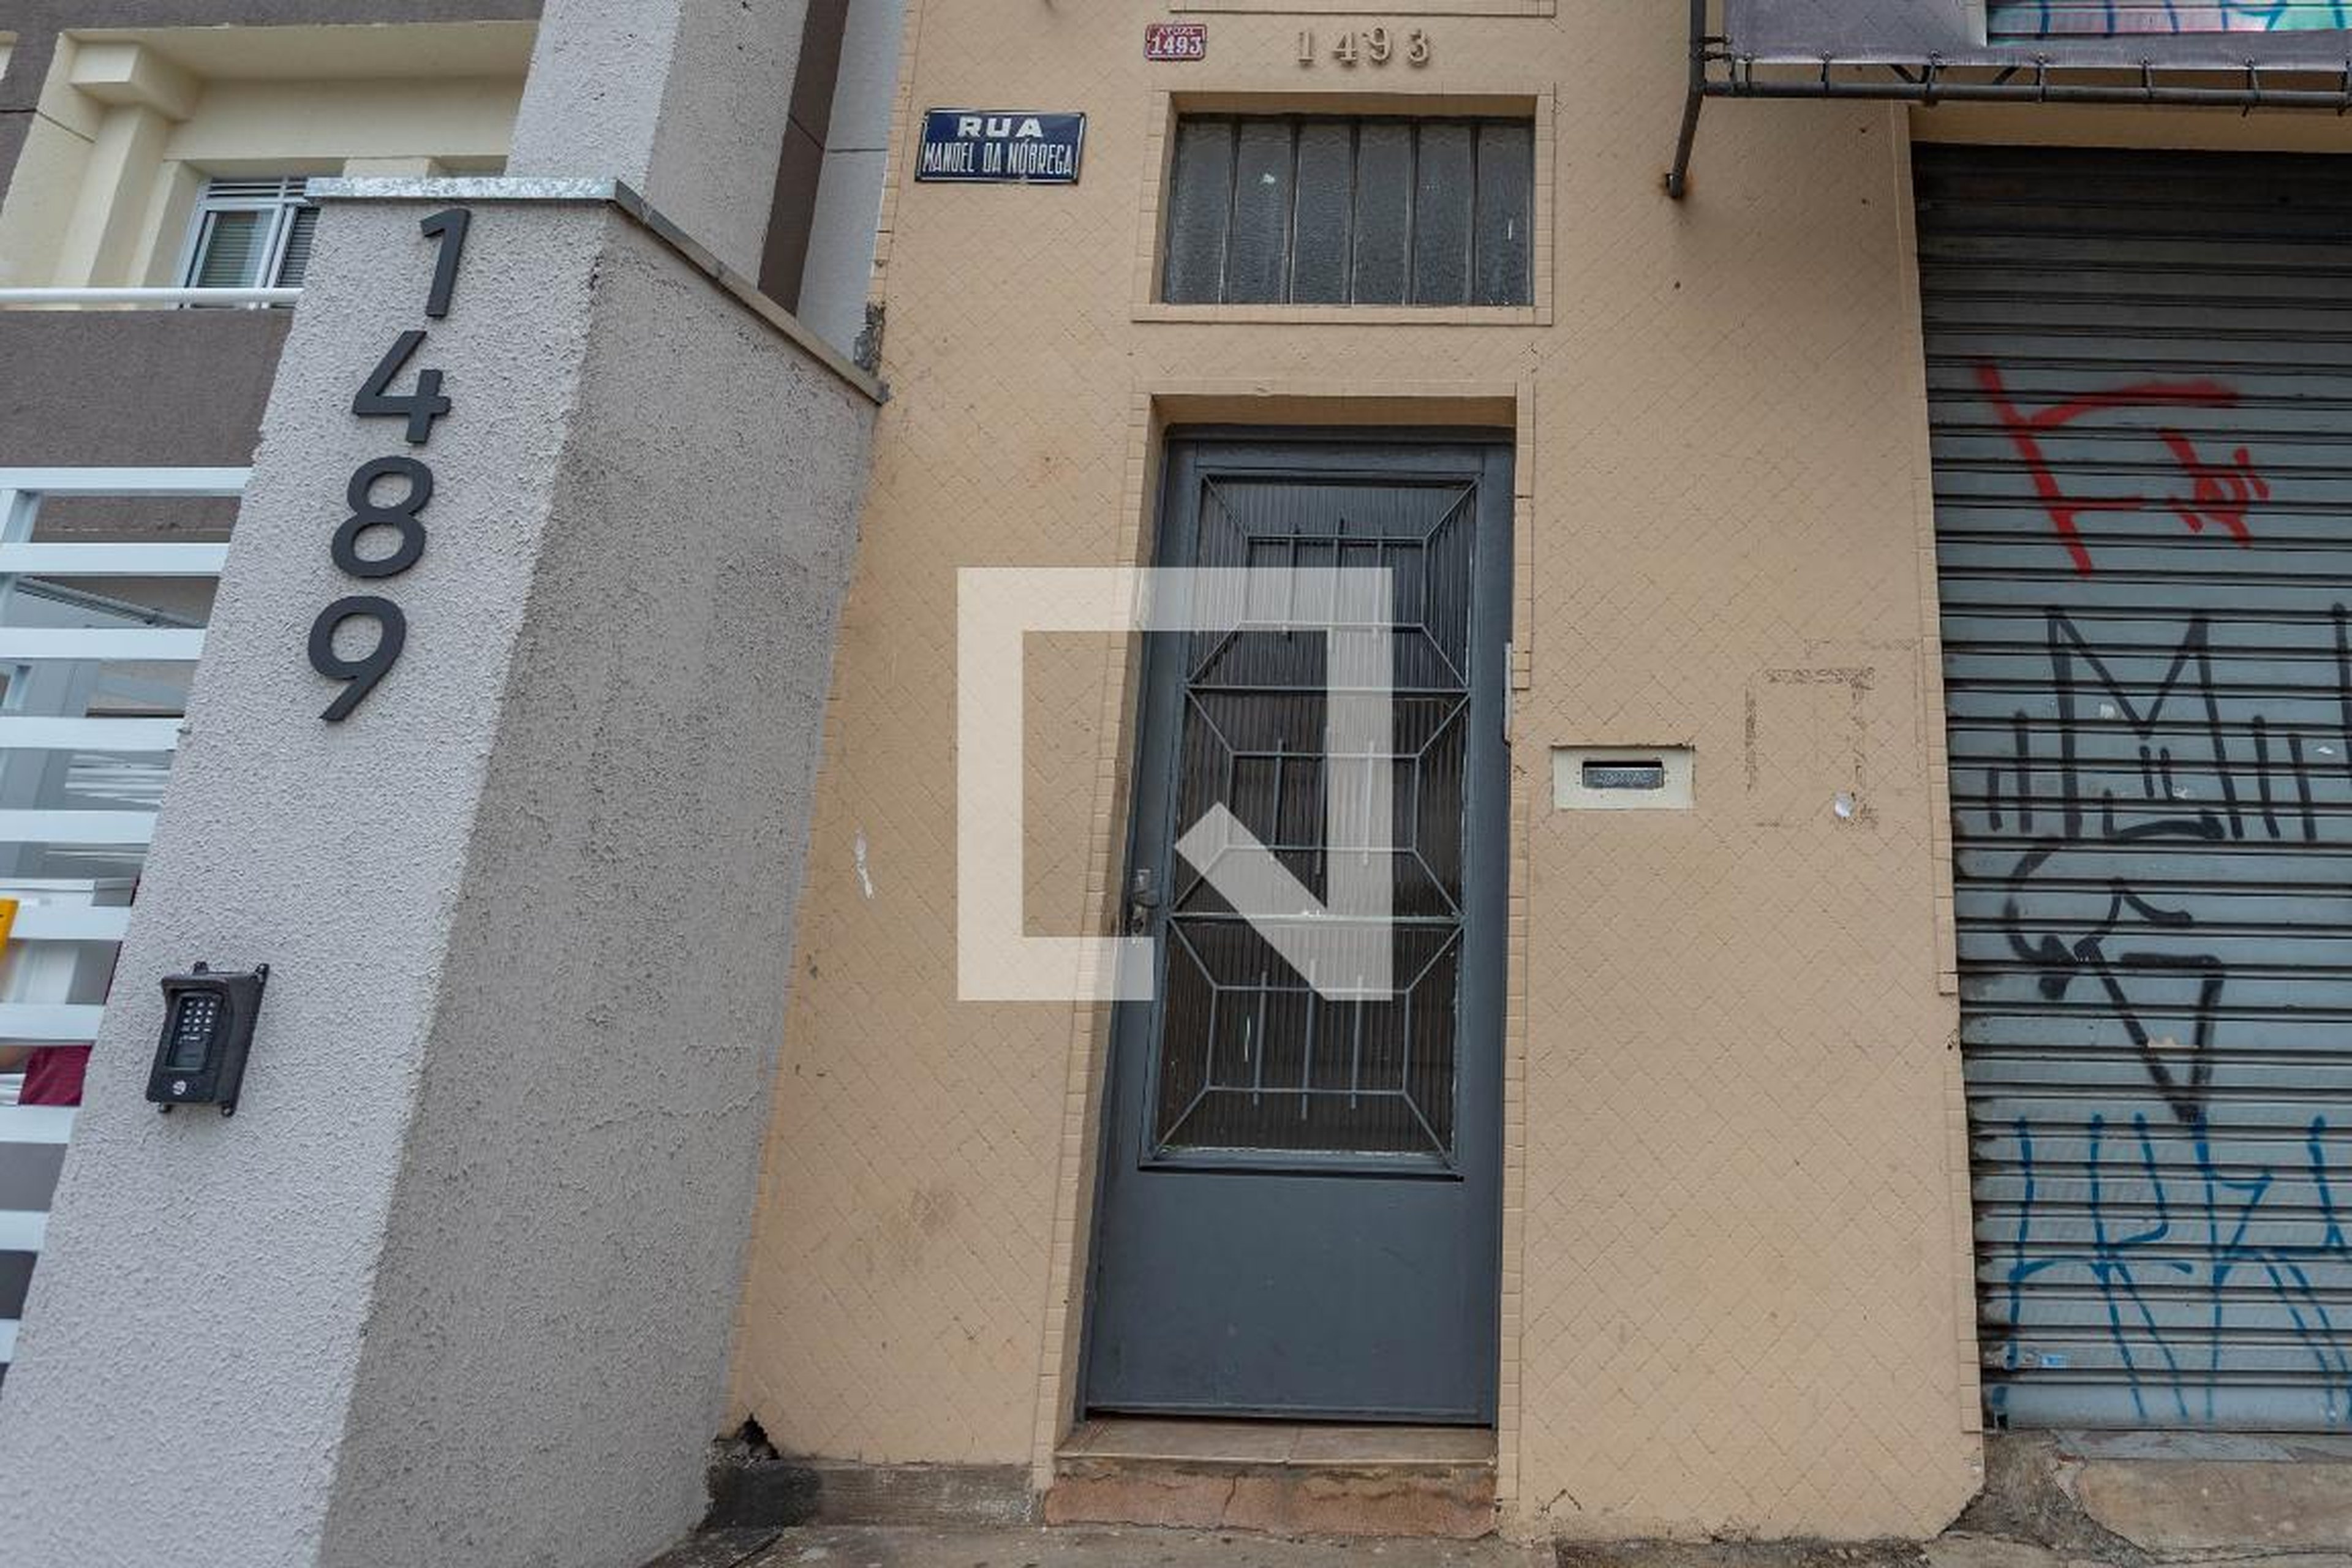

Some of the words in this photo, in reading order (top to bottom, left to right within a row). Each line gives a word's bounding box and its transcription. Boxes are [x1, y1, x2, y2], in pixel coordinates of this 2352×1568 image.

[1151, 36, 1202, 54] 1493
[1298, 27, 1429, 67] 1493
[957, 116, 1043, 138] RUA
[922, 142, 975, 173] MANOEL
[982, 142, 1002, 173] DA
[1007, 138, 1072, 175] NÓBREGA
[307, 207, 472, 722] 1489
